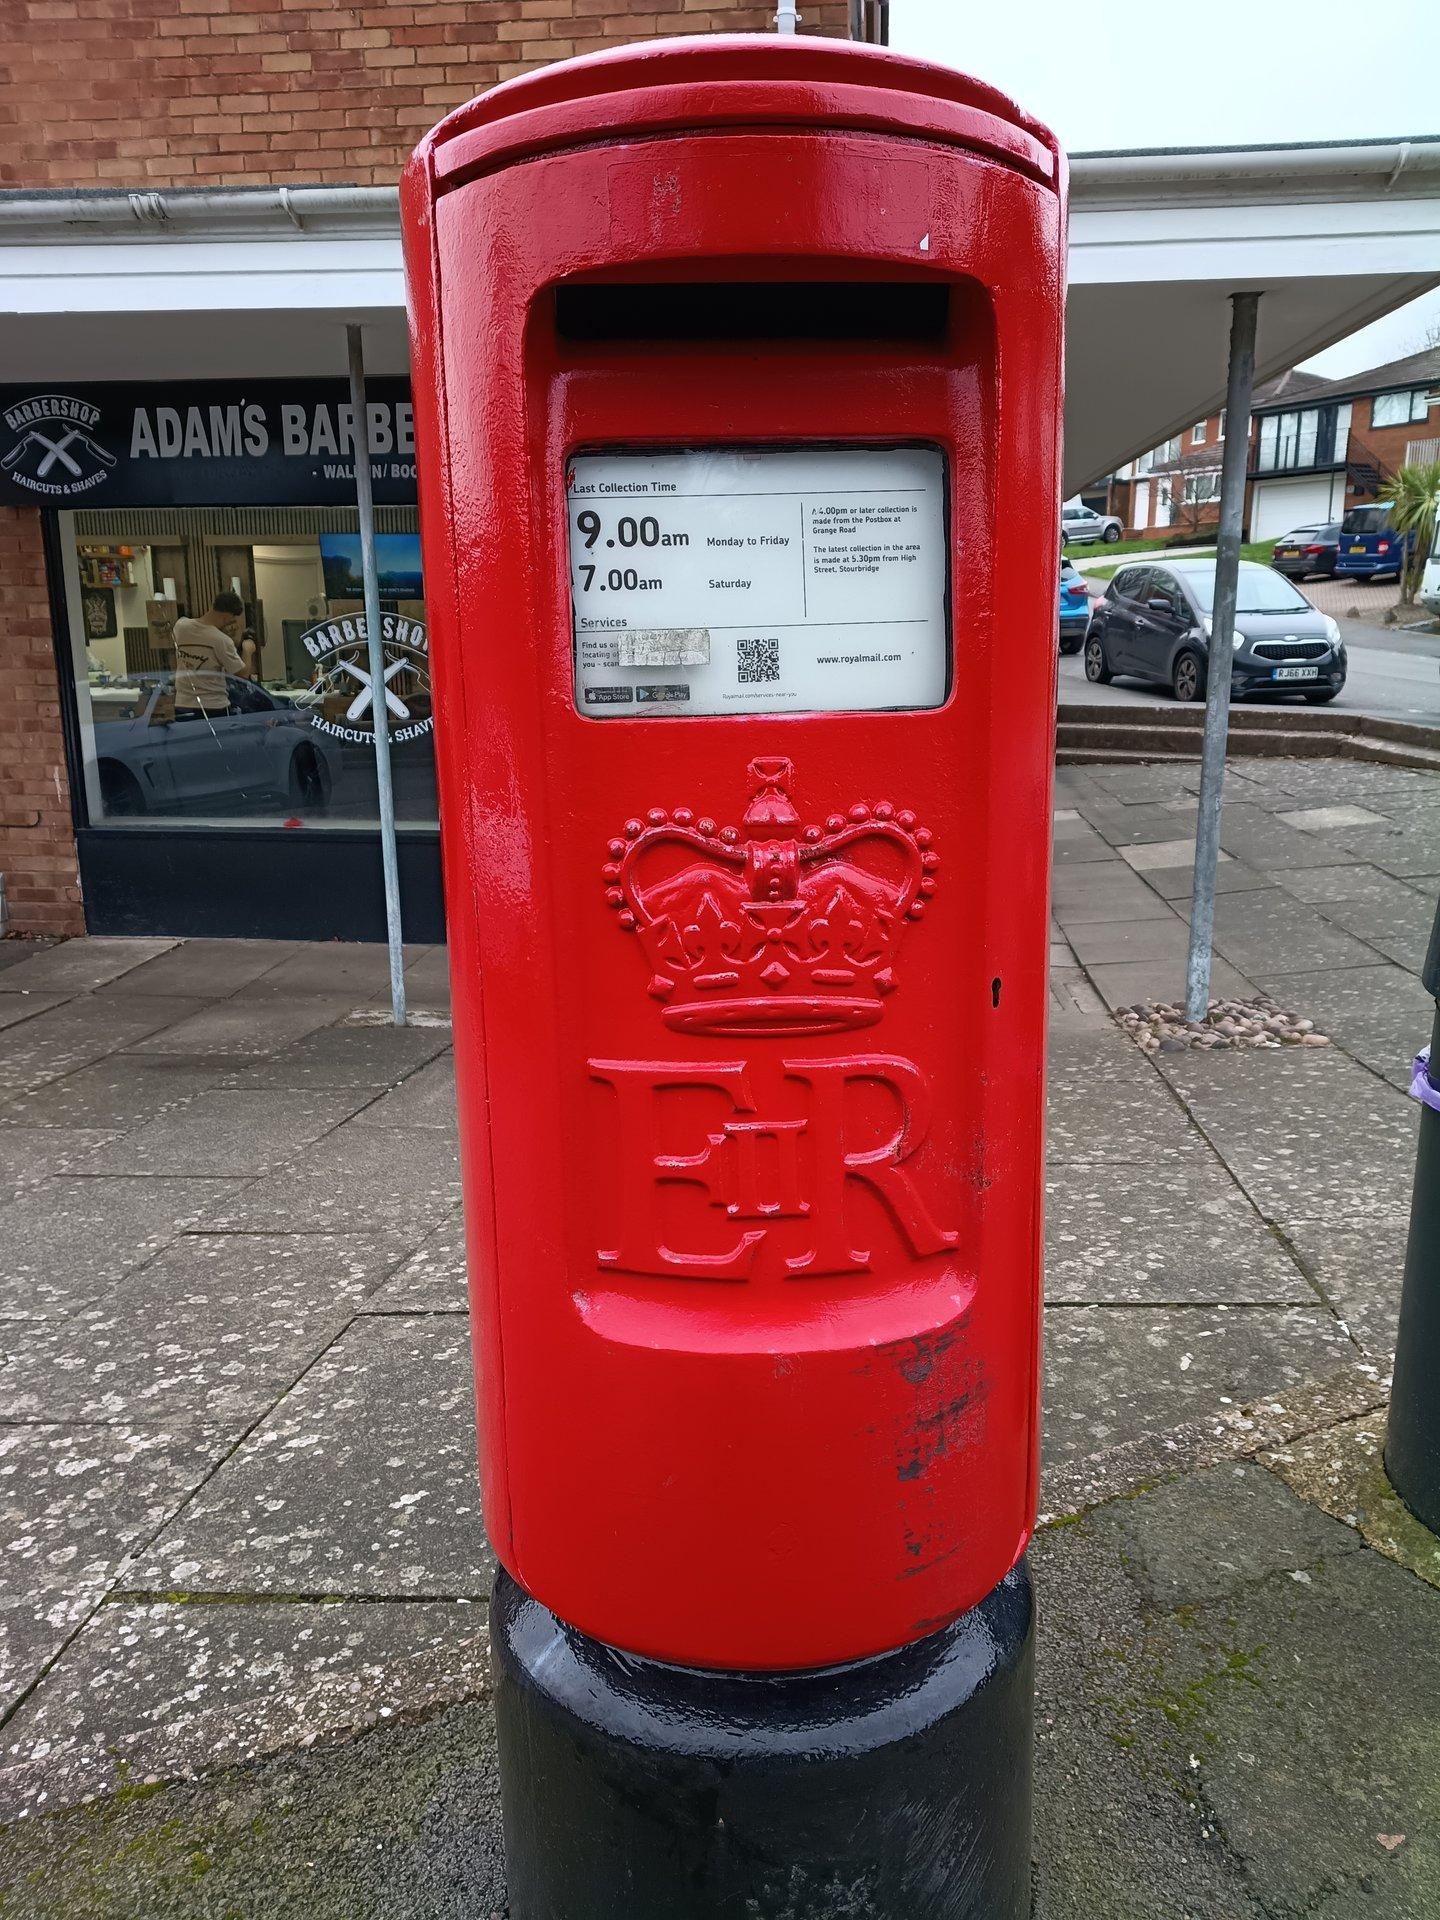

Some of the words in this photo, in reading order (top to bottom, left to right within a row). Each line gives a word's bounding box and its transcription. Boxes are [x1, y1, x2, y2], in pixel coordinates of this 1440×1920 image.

[5, 399, 100, 431] BARBERSHOP
[129, 398, 269, 459] ADAM'S
[12, 471, 62, 495] HAIRCUTS
[63, 484, 71, 495] &
[71, 469, 107, 493] SHAVES
[573, 483, 596, 494] Last
[599, 482, 648, 493] Collection
[651, 481, 677, 492] Time
[859, 506, 876, 514] later
[812, 517, 832, 525] made
[833, 516, 850, 524] from
[852, 516, 864, 524] the
[893, 515, 902, 523] at
[577, 510, 690, 549] 9.00am
[707, 537, 744, 547] Monday
[747, 537, 757, 546] to
[760, 536, 790, 547] Friday
[812, 526, 838, 535] Grange
[839, 526, 857, 534] Road
[821, 556, 841, 564] made
[842, 556, 850, 564] at
[851, 555, 881, 564] 5.30pm
[882, 554, 900, 562] from
[900, 554, 917, 563] High
[813, 566, 838, 574] Street,
[839, 565, 880, 574] Stourbridge
[578, 565, 663, 592] 7.00am
[708, 579, 752, 590] Saturday
[580, 616, 628, 629] Services
[581, 641, 597, 649] Find
[582, 651, 611, 660] locating
[816, 652, 902, 665] www.royalmail.com
[582, 661, 596, 670] you
[1278, 668, 1300, 678] RJ66
[1301, 667, 1318, 677] XXH
[598, 693, 612, 702] App
[612, 693, 630, 701] Store
